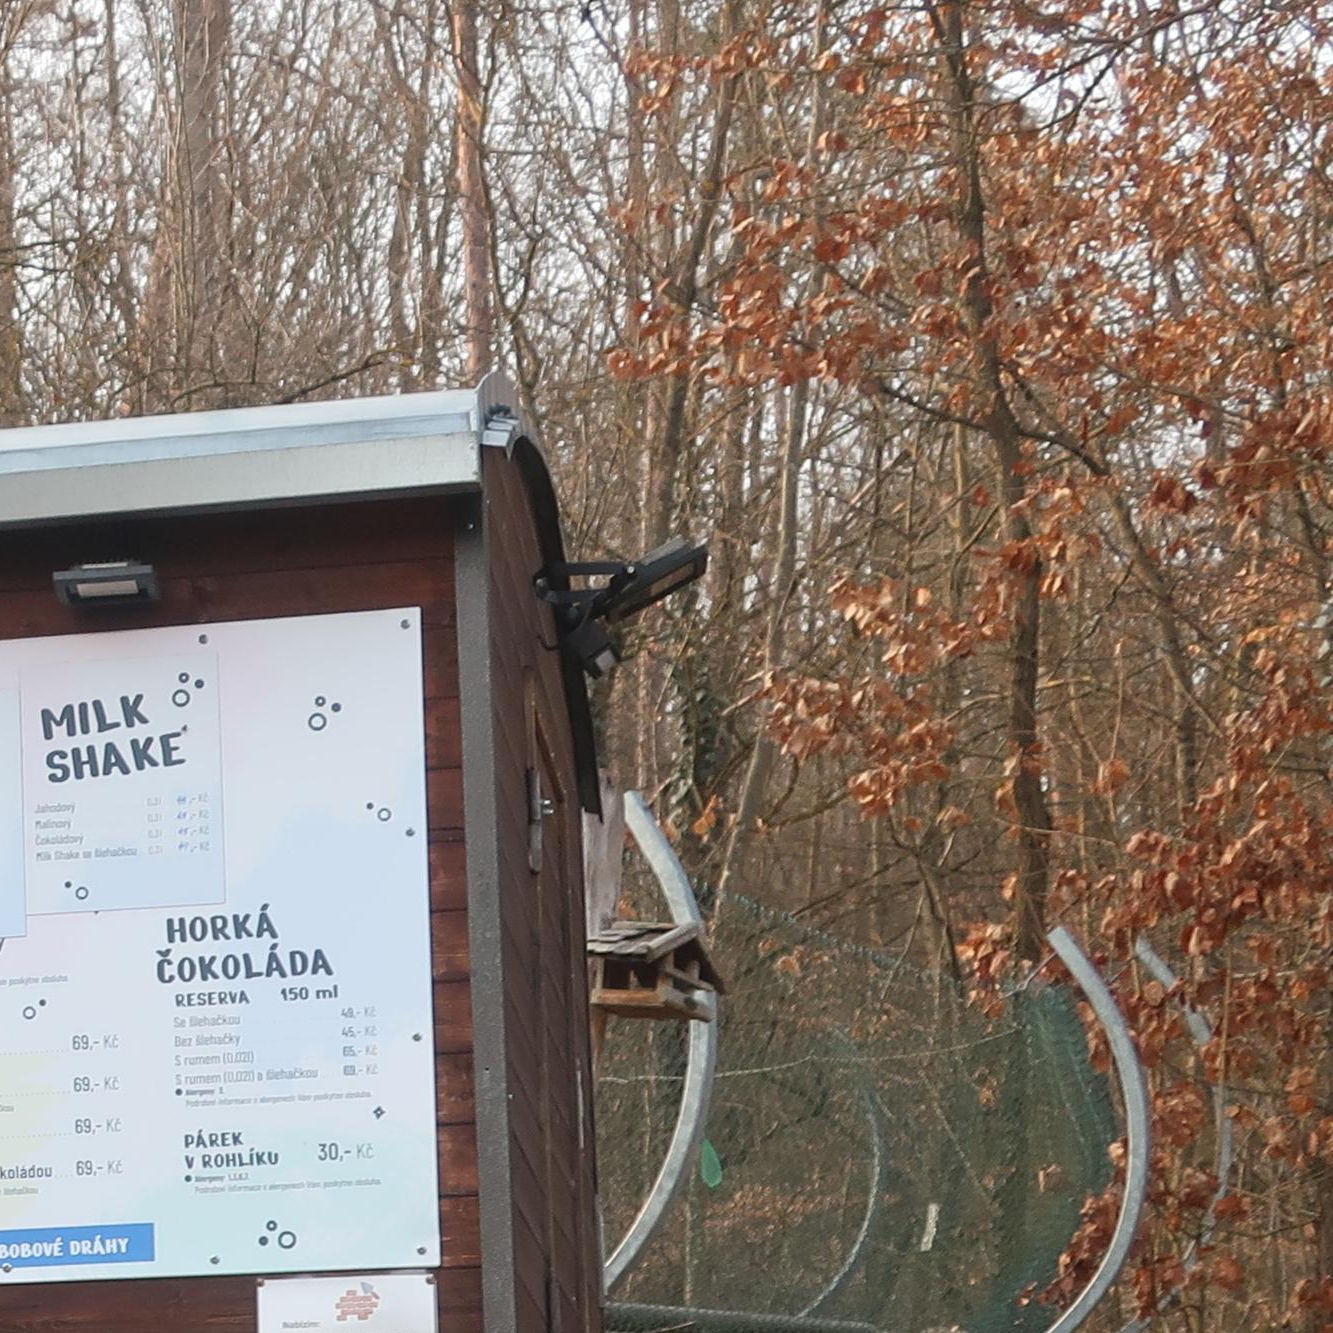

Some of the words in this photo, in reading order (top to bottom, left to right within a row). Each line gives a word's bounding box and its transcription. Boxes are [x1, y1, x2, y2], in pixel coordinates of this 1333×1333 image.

[41, 693, 149, 740] MILK
[46, 732, 186, 784] SHAKE
[166, 903, 279, 944] HORKÁ
[155, 942, 334, 984] ČOKOLÁDA
[175, 990, 250, 1007] RESERVA
[280, 986, 309, 1001] 150
[316, 984, 338, 999] ml
[173, 1016, 186, 1028] Se
[72, 1034, 99, 1052] 69,-
[103, 1033, 119, 1048] Kč
[174, 1036, 192, 1047] Bez
[175, 1055, 182, 1066] S
[184, 1055, 221, 1065] rumem
[73, 1076, 100, 1093] 69,-
[104, 1075, 120, 1090] Kč
[175, 1074, 182, 1085] S
[185, 1074, 221, 1085] rumem
[75, 1118, 102, 1135] 69,-
[106, 1117, 122, 1132] Kč
[184, 1129, 243, 1149] PÁREK
[185, 1155, 195, 1169] V
[202, 1147, 279, 1168] ROHLÍKU
[318, 1143, 351, 1162] 30,-
[356, 1143, 374, 1159] Kč
[76, 1160, 104, 1177] 69,-
[107, 1159, 123, 1174] Kč
[70, 1234, 129, 1256] DRÁHY
